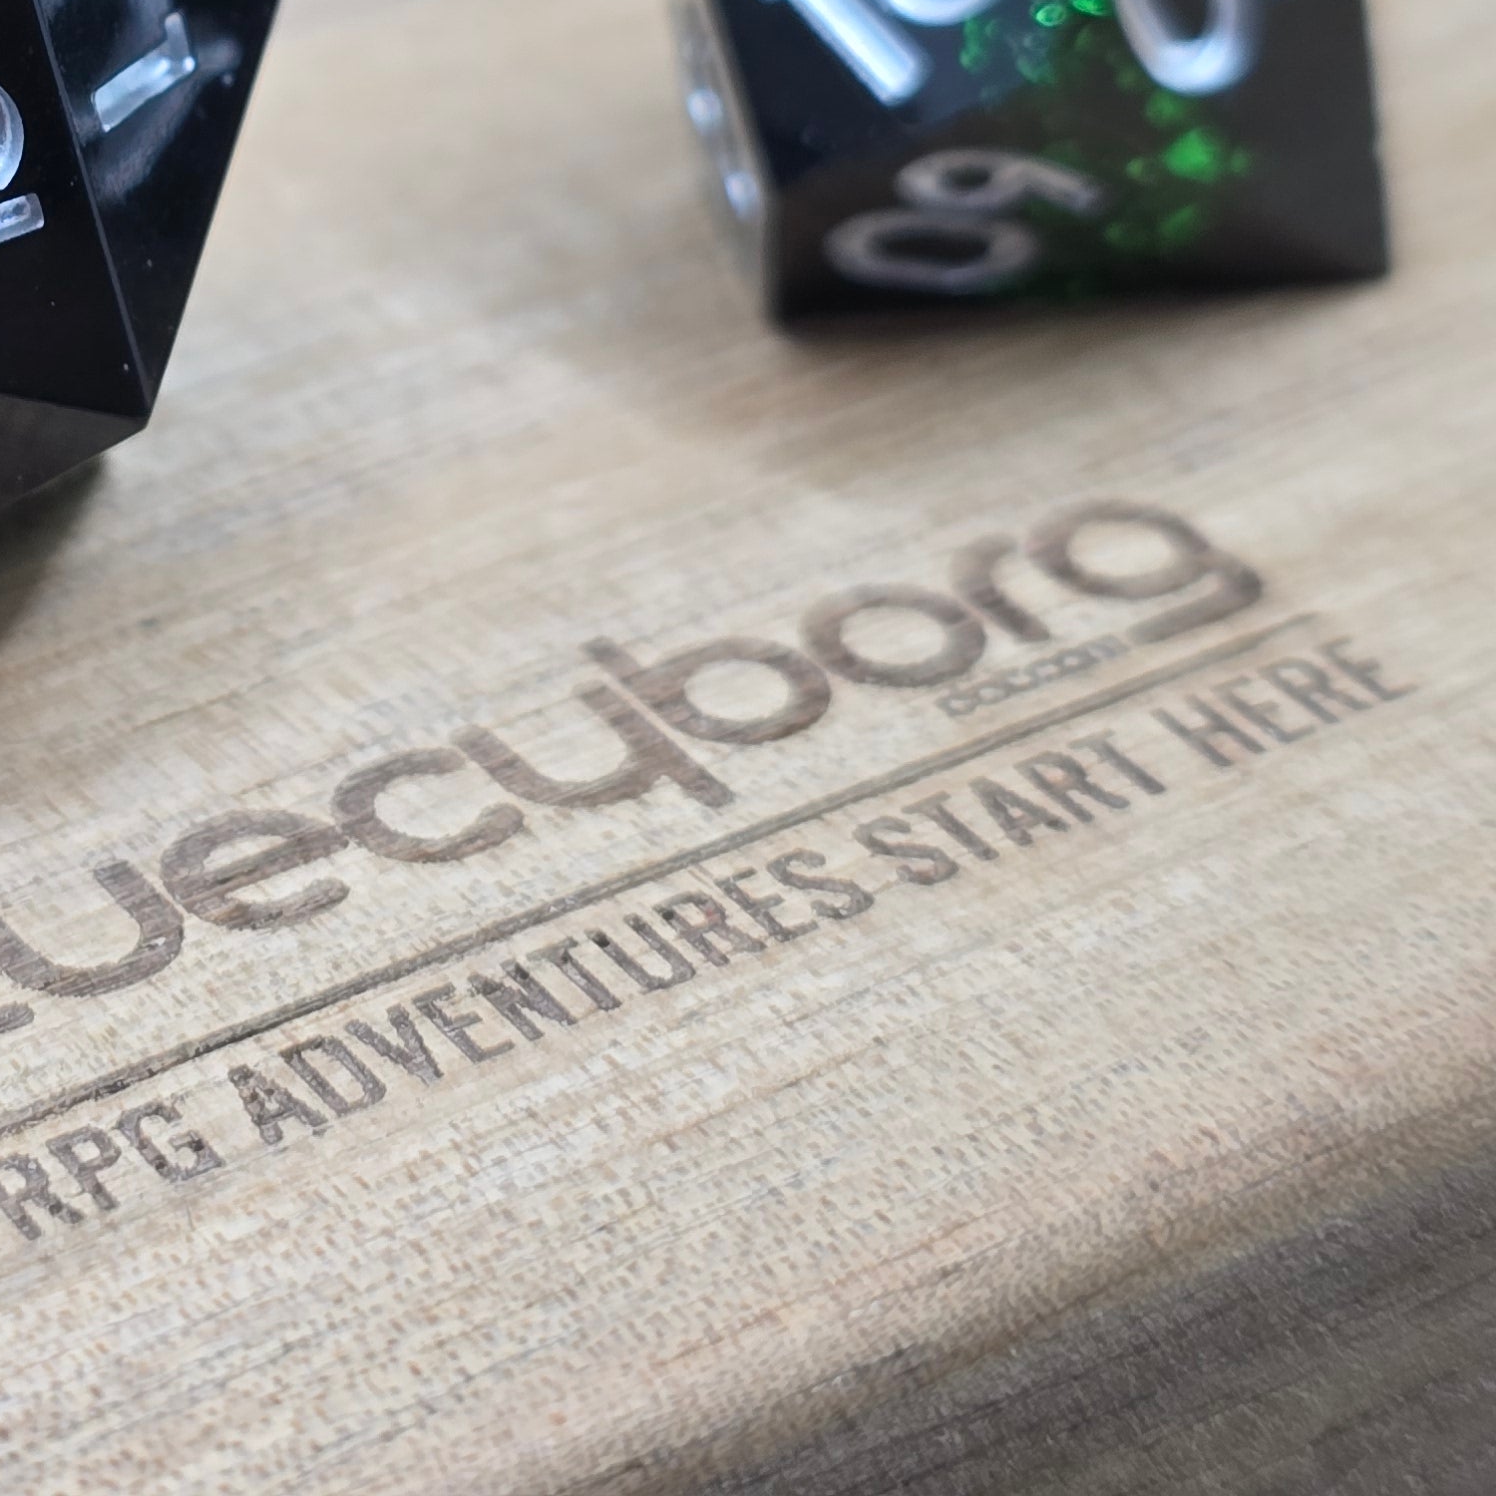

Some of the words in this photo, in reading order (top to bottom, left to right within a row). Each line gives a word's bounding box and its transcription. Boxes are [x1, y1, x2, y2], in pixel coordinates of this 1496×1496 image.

[228, 850, 875, 1145] ADVENTURES
[855, 729, 1166, 886] START
[1152, 636, 1418, 768] HERE
